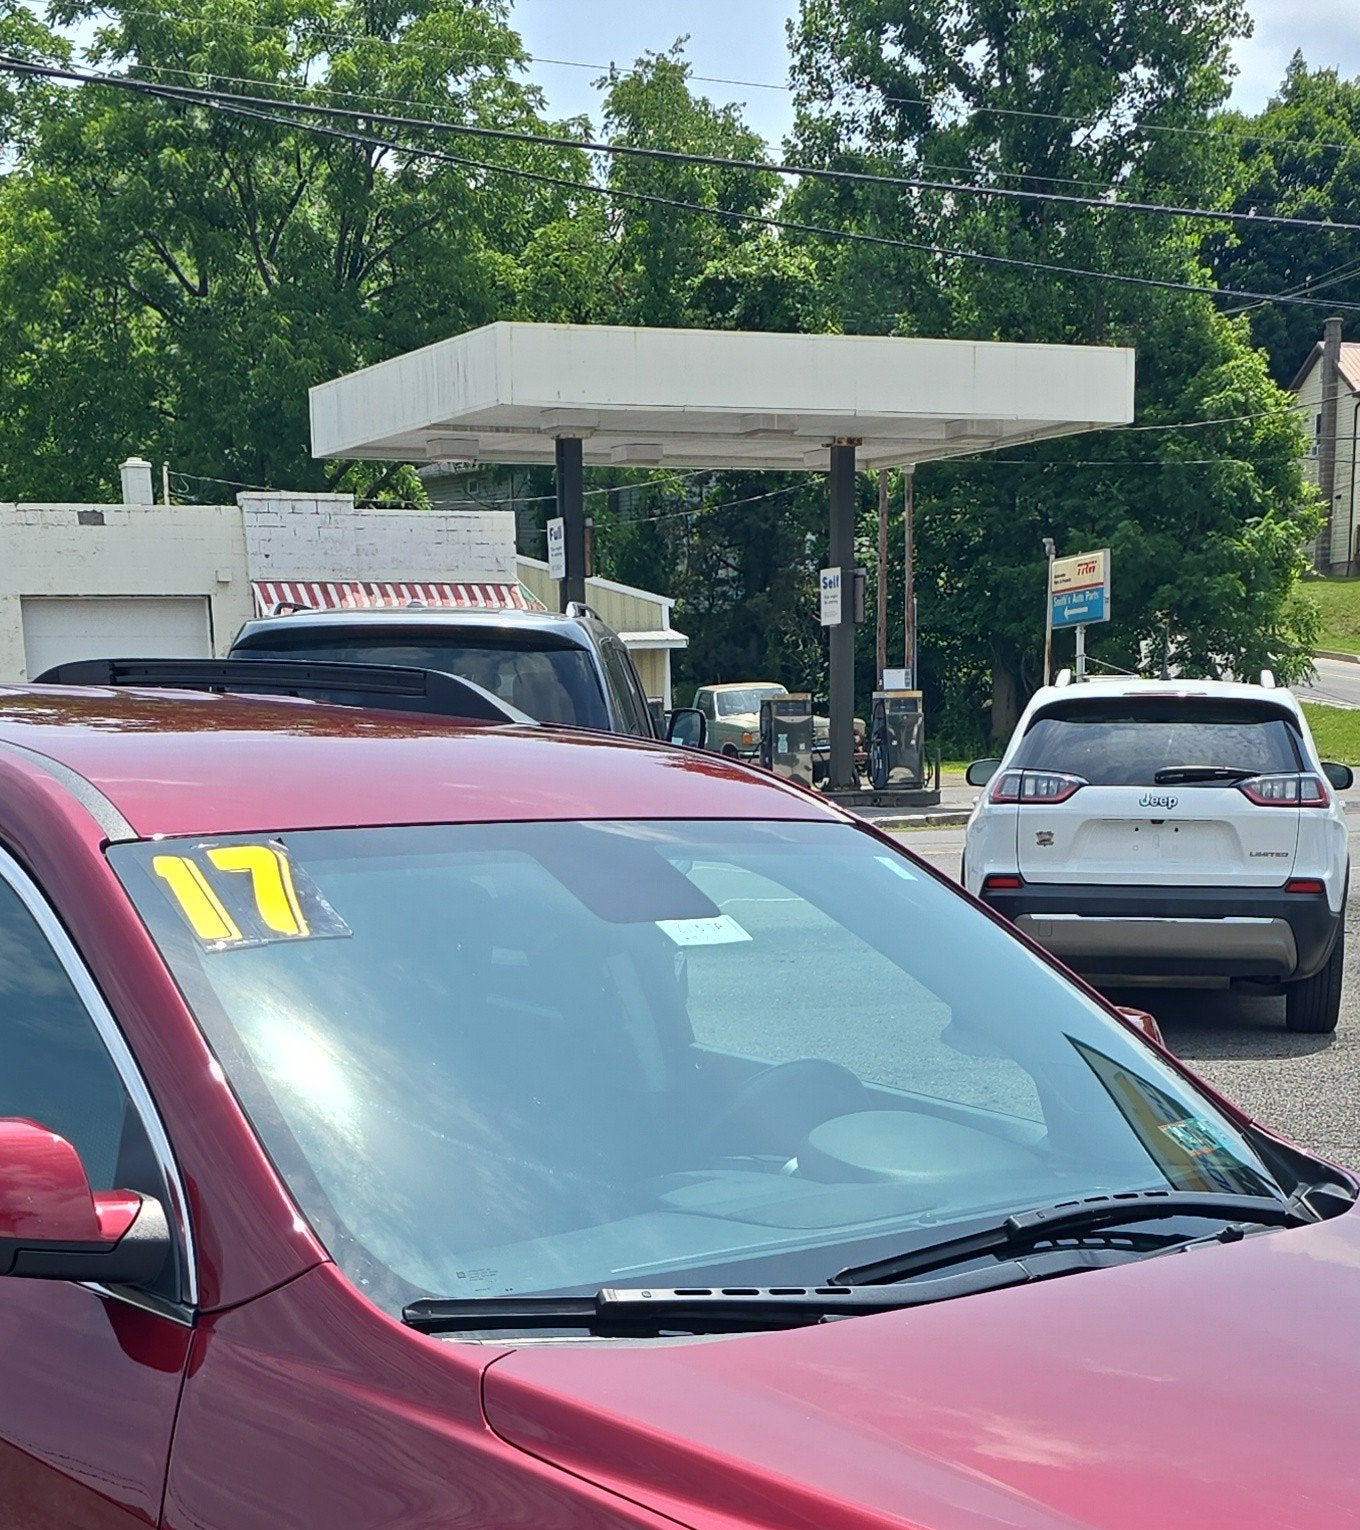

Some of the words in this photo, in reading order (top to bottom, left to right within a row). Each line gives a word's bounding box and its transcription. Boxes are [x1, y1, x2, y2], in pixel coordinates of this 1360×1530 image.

[1139, 792, 1179, 810] Jeep
[1249, 851, 1289, 859] LIMITED
[152, 845, 310, 941] 17
